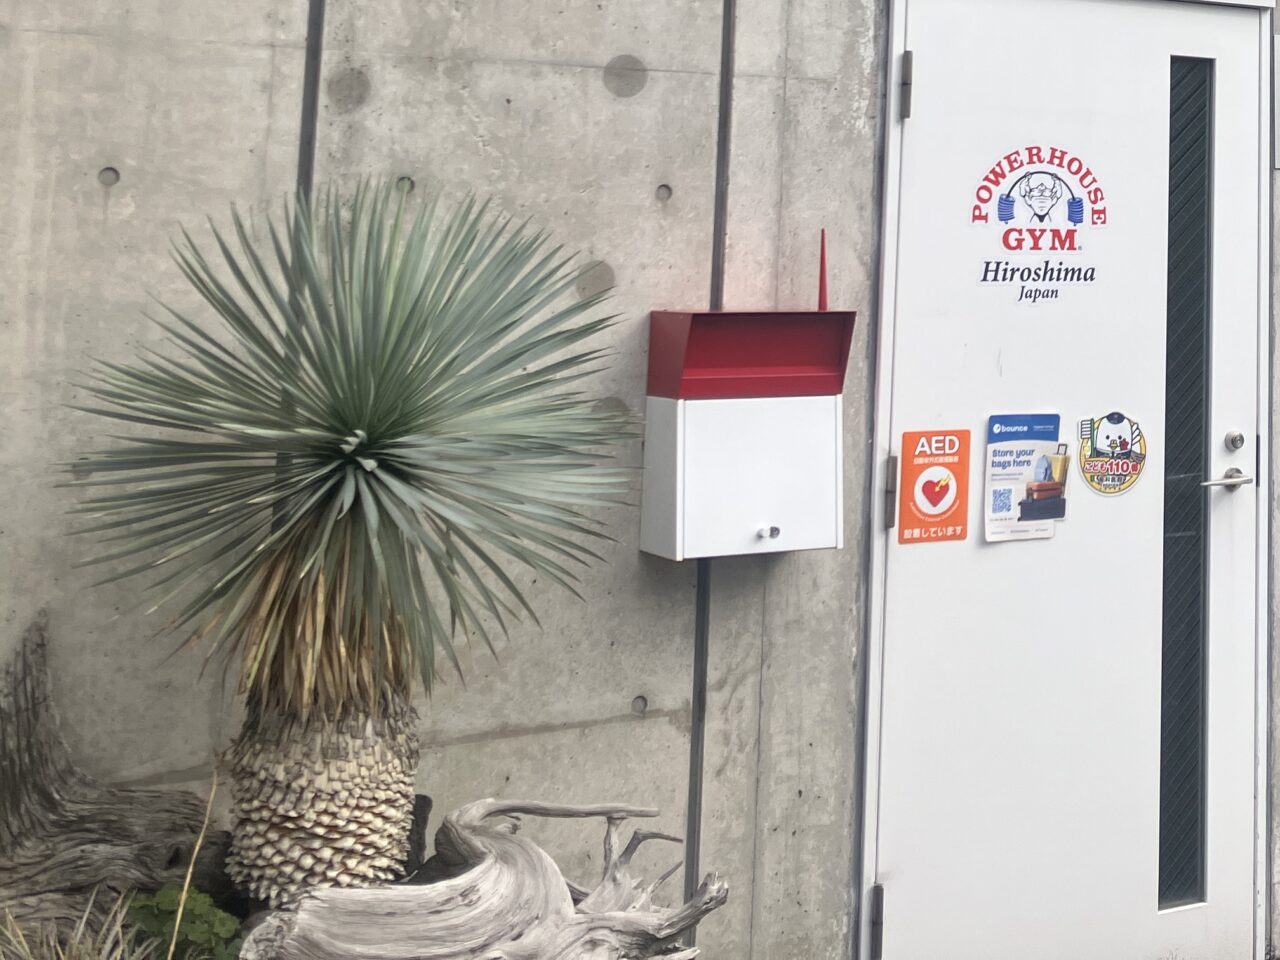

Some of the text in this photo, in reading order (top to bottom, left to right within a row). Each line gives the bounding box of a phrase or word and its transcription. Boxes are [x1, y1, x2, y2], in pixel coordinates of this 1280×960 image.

[971, 145, 1107, 226] POWERHOUSE
[1002, 227, 1078, 251] GYM
[980, 259, 1096, 283] Hiroshima
[1018, 285, 1059, 303] Japan
[1001, 424, 1029, 433] bounce
[914, 435, 960, 455] AED
[992, 448, 1035, 459] Store your
[991, 459, 1031, 470] bags here
